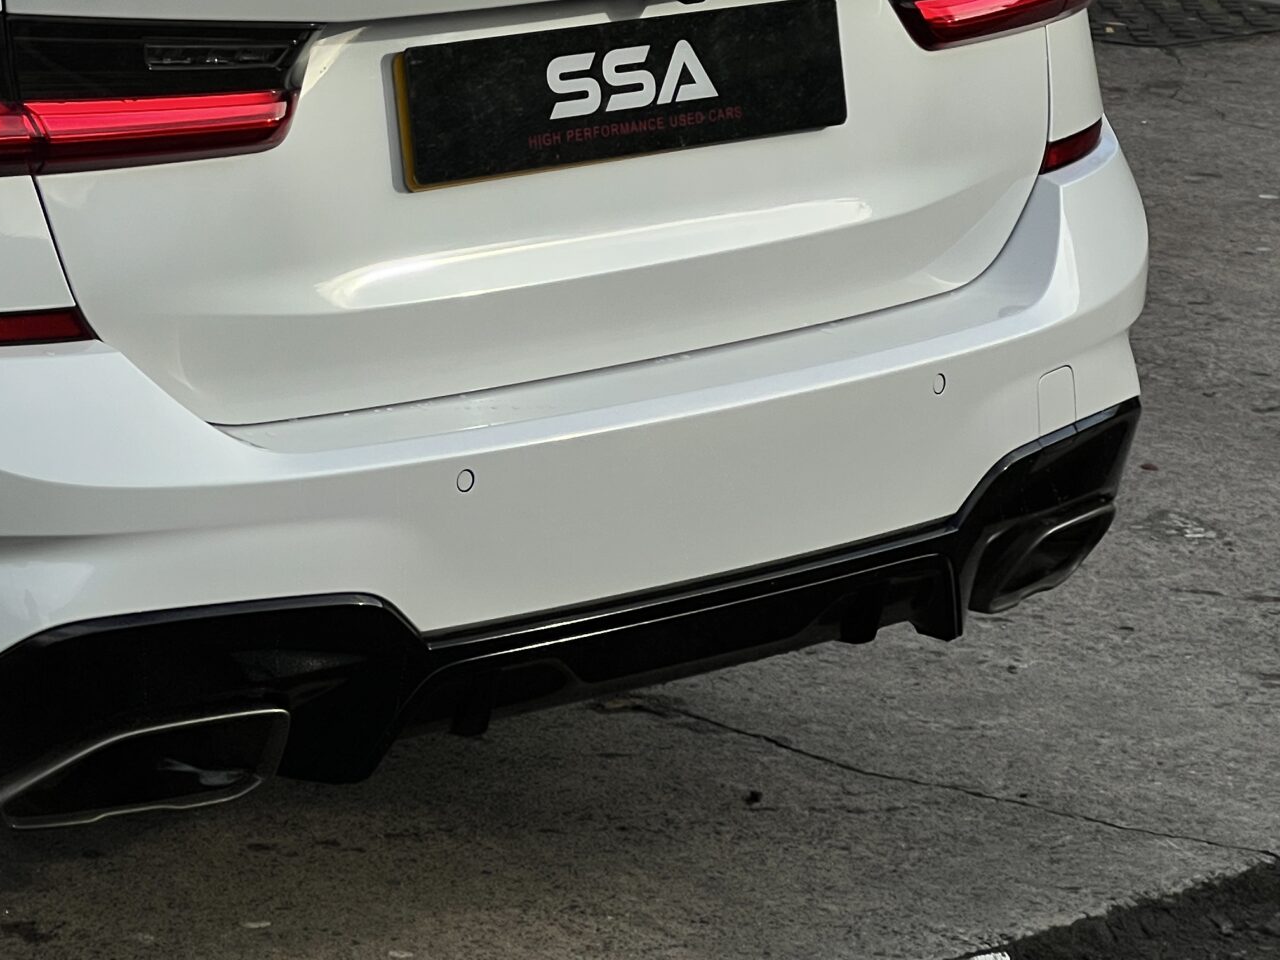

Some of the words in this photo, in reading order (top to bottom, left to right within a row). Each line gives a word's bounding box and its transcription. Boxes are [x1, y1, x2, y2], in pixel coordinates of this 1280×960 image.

[546, 39, 719, 120] SSA
[528, 131, 562, 150] HIGH
[566, 114, 665, 142] PERFORMANCE
[669, 110, 705, 129] USED
[707, 105, 744, 122] CARS
